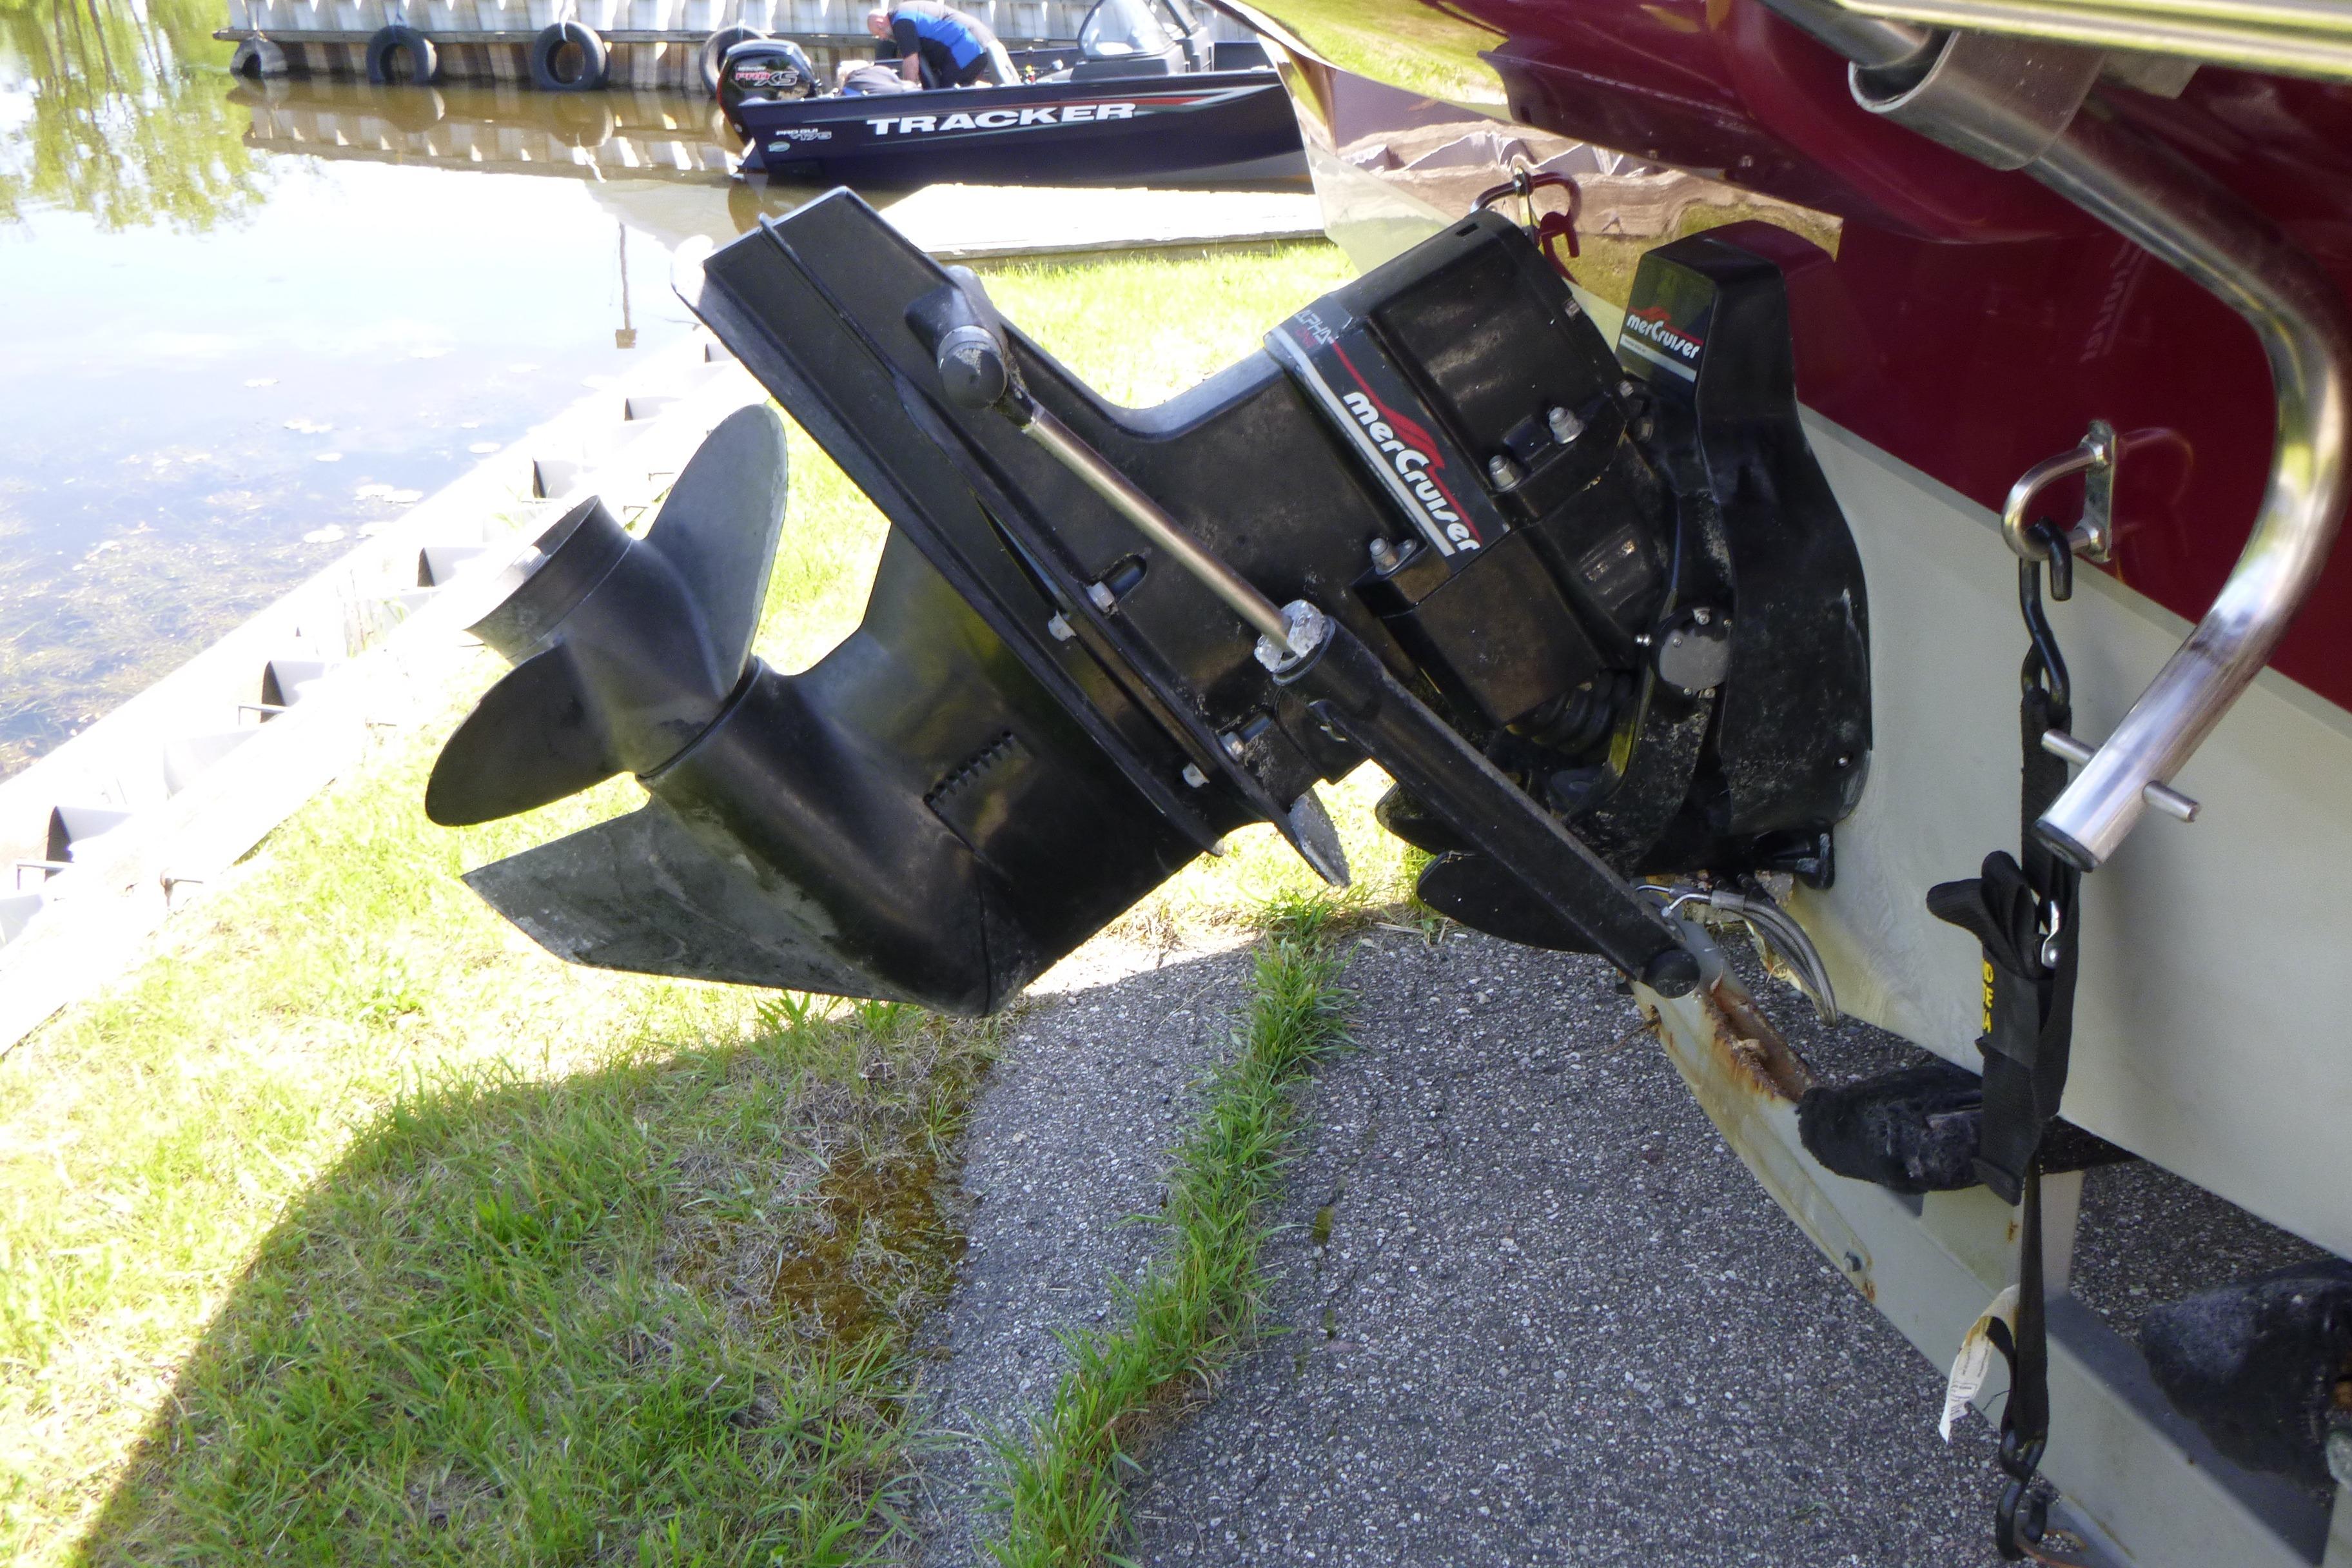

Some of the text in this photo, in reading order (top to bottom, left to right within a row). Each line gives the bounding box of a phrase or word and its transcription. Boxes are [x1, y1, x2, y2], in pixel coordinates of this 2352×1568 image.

[866, 103, 1136, 136] TRACKER
[1293, 309, 1331, 345] ALPHA
[1626, 314, 1701, 359] merCruiser
[1342, 391, 1481, 551] merCruiser
